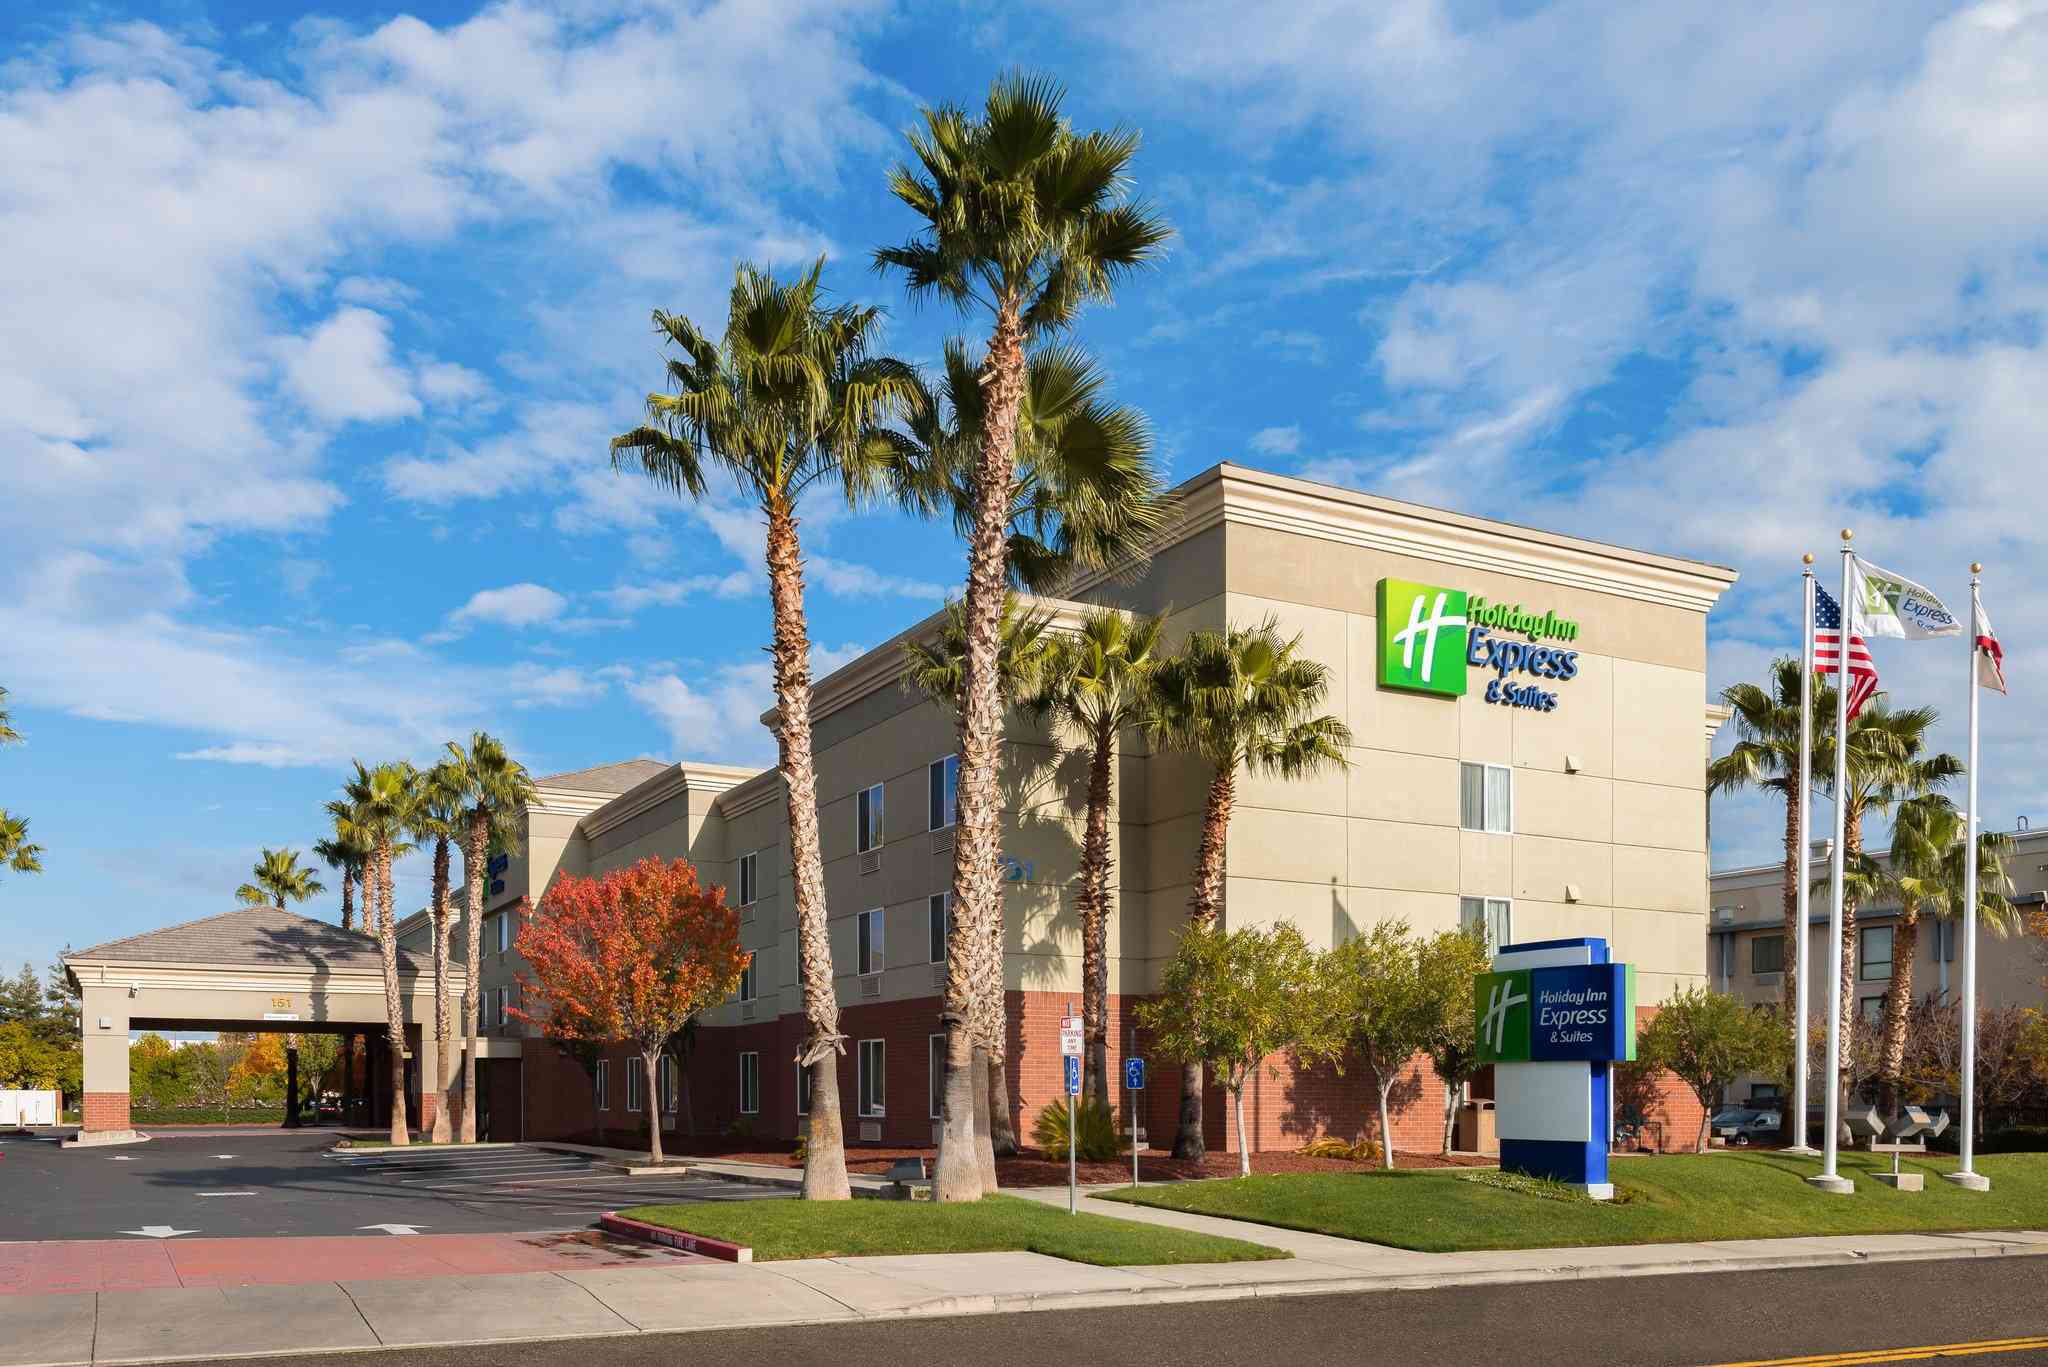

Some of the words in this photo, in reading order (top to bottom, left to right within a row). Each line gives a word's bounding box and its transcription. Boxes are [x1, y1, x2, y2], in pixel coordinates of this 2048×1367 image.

[1467, 597, 1545, 642] Holiday
[1544, 606, 1579, 641] Inn
[1903, 598, 1953, 625] Express
[1467, 626, 1579, 680] Express
[1485, 680, 1502, 704] &
[1501, 682, 1558, 711] Suites
[1540, 989, 1585, 1005] Holiday
[1586, 988, 1607, 1001] Inn
[1540, 1007, 1607, 1029] Express
[1550, 1031, 1558, 1042] &
[1559, 1030, 1593, 1042] Suites
